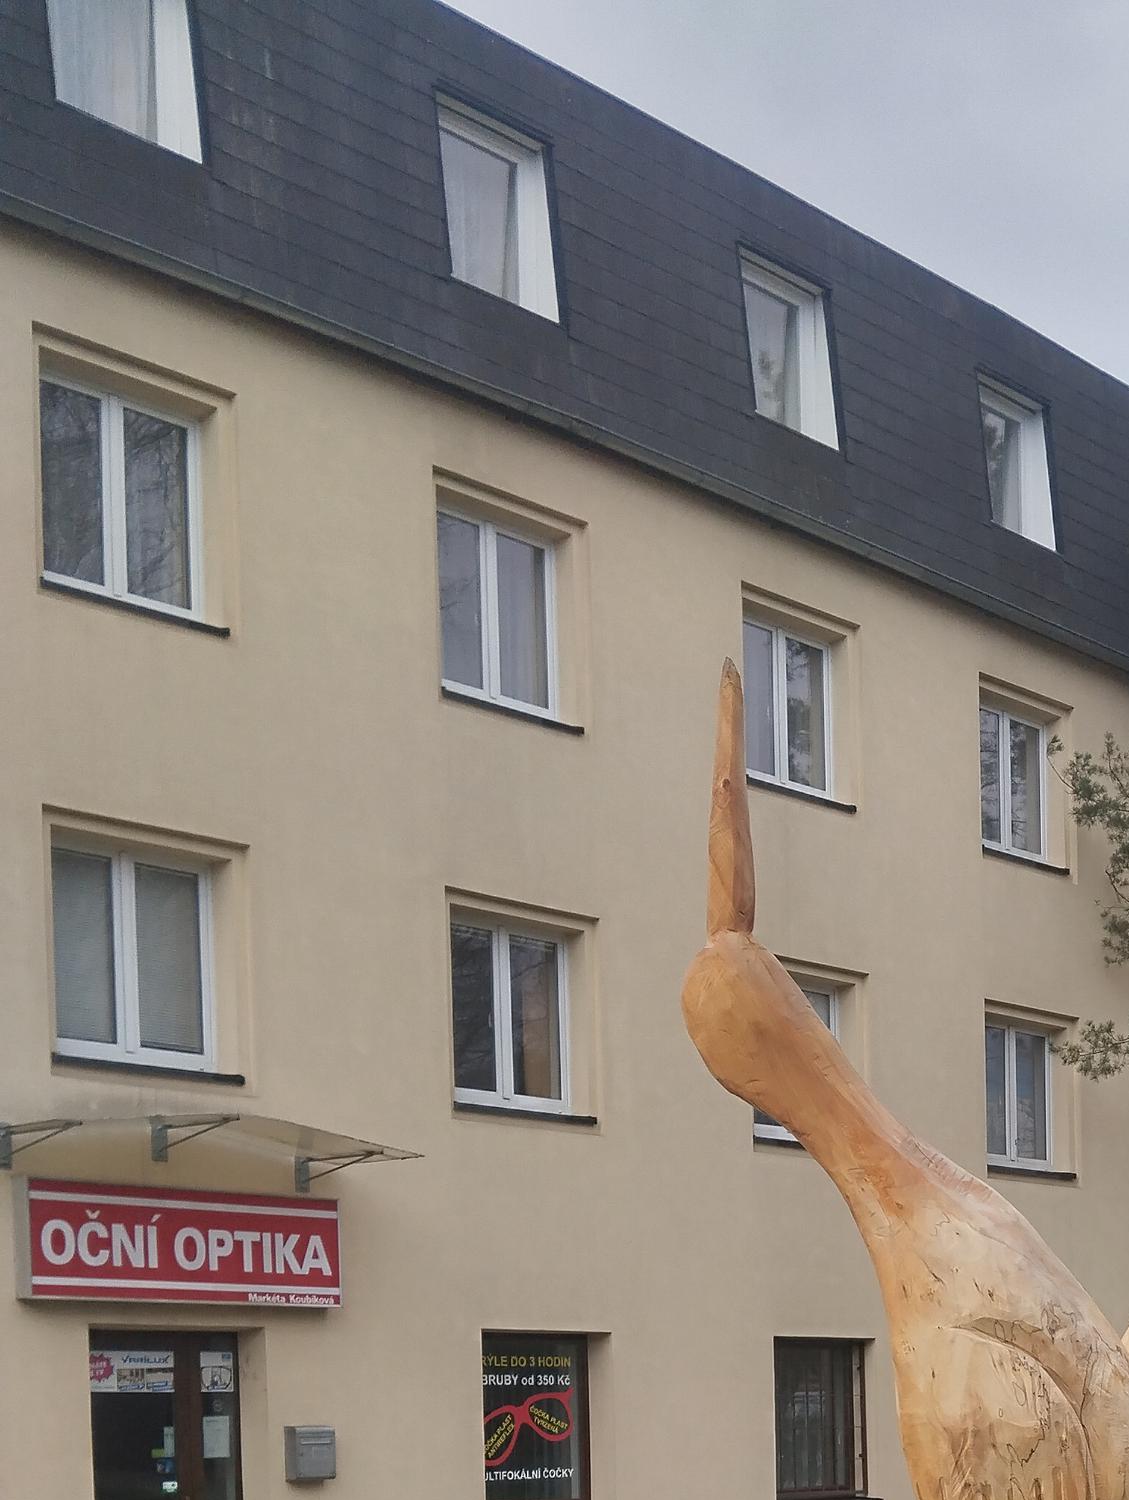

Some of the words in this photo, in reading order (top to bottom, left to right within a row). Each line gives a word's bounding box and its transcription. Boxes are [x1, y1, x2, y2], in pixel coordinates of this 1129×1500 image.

[41, 1210, 161, 1268] OČNÍ
[173, 1227, 333, 1276] OPTIKA
[248, 1293, 286, 1303] Markéta
[511, 1356, 527, 1367] DO
[529, 1356, 536, 1367] 3
[538, 1356, 571, 1367] HODIN
[521, 1375, 534, 1386] od
[536, 1374, 555, 1386] 350
[557, 1374, 571, 1386] Kč
[543, 1467, 574, 1479] ČOČKY
